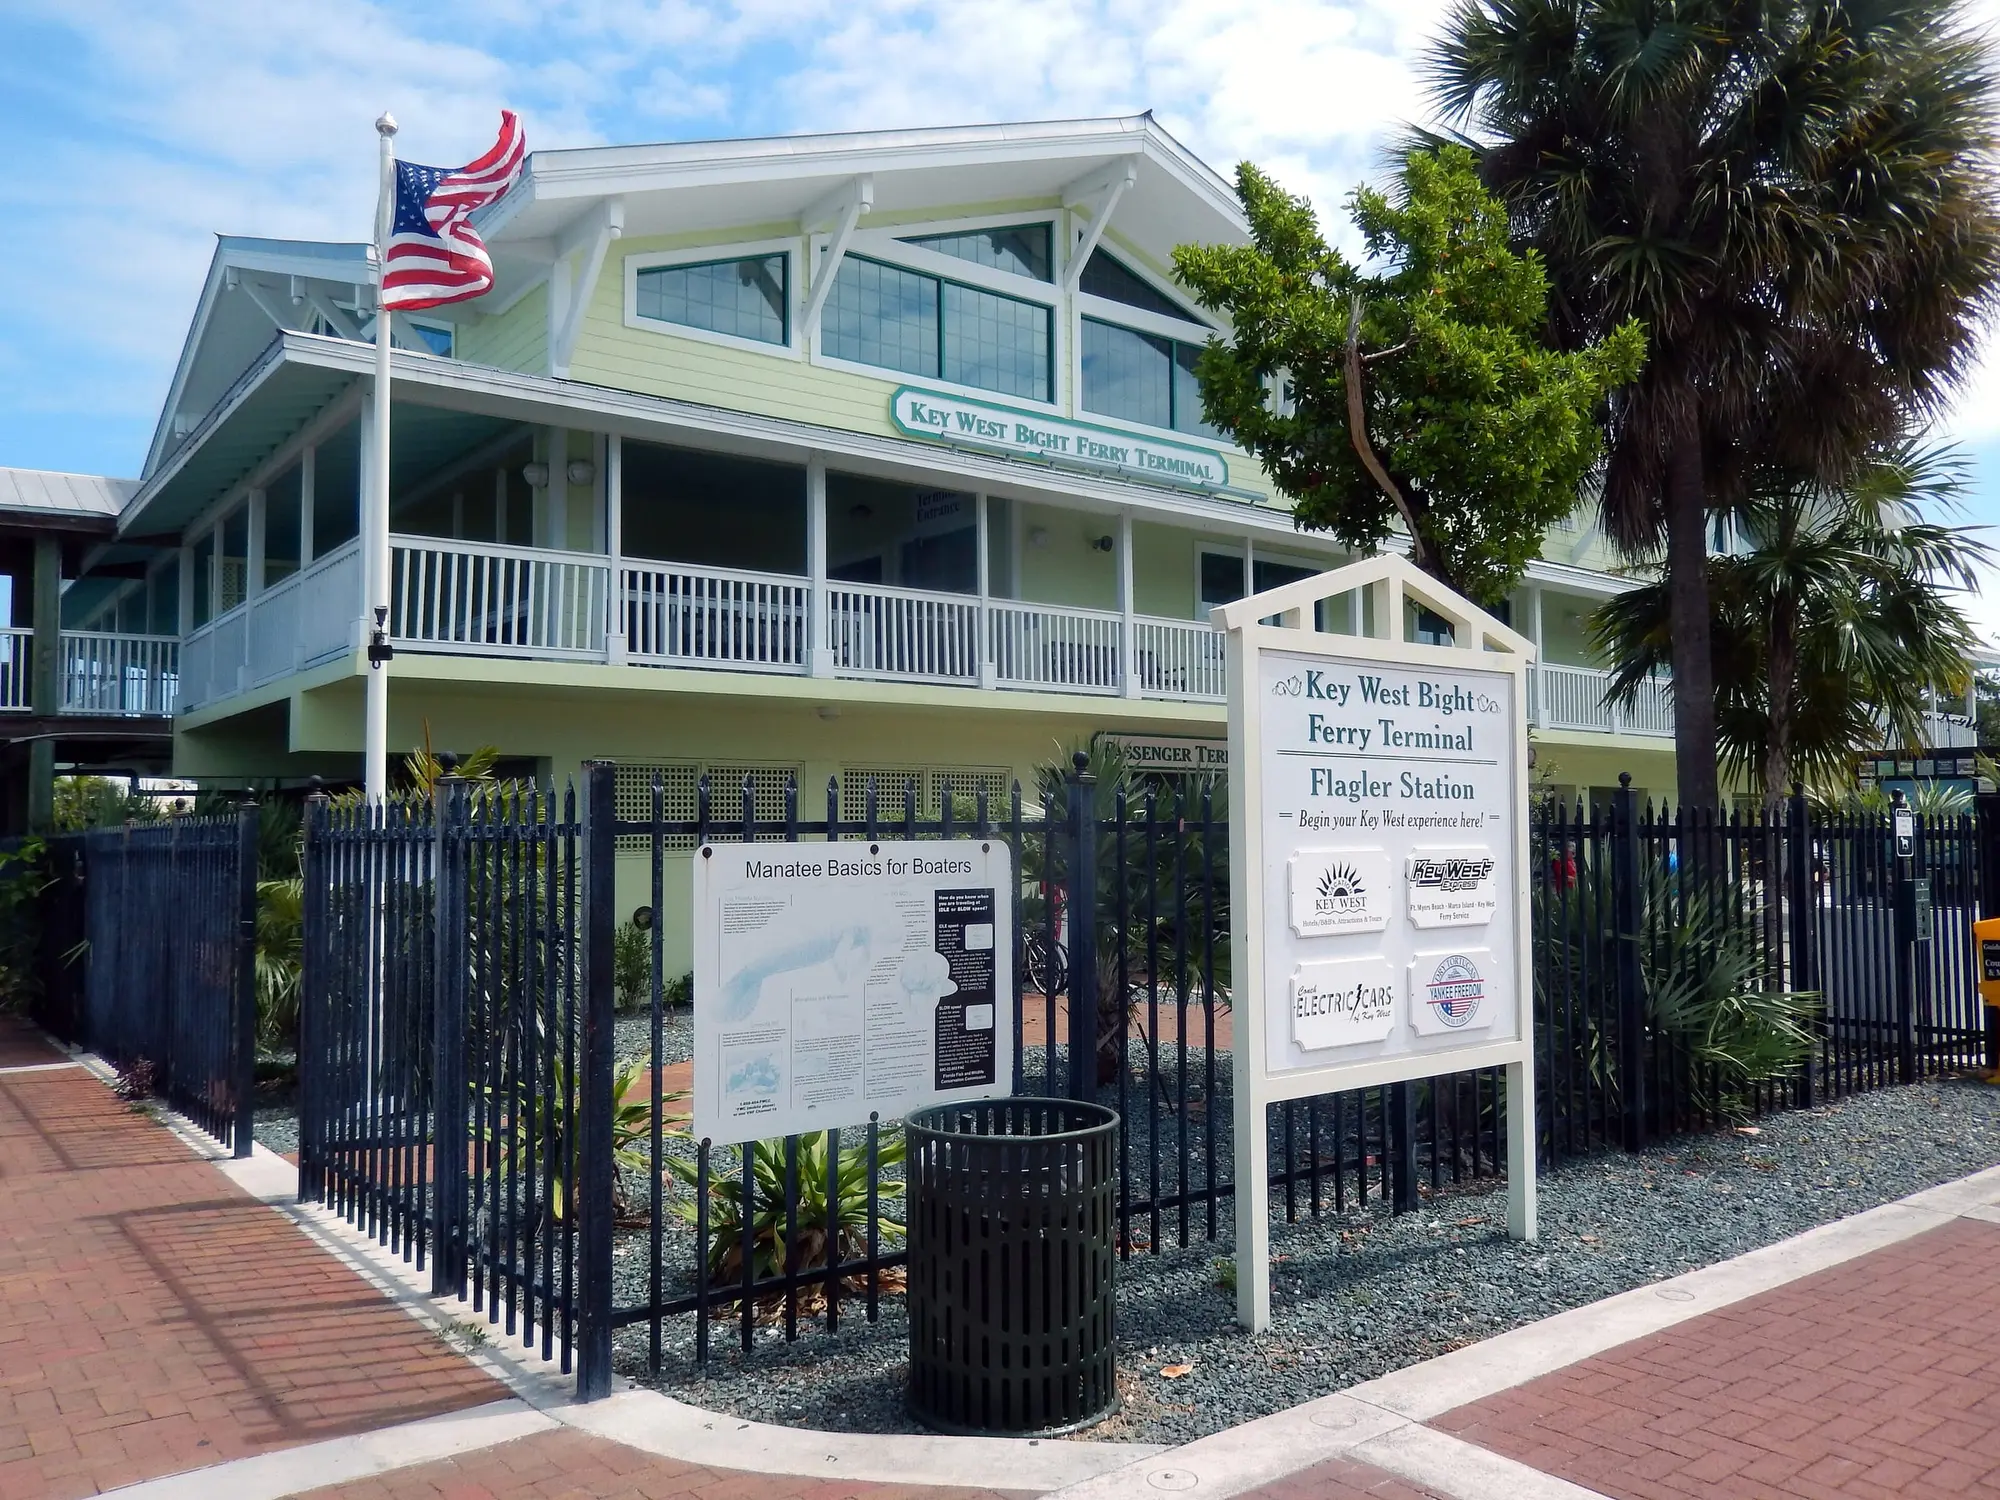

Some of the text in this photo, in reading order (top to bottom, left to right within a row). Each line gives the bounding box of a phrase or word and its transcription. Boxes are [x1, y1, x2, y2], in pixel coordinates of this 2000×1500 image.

[910, 401, 1214, 481] KEY WEST BIGHT FERRY TERMINAL
[1306, 670, 1475, 715] Key West Bight
[1308, 713, 1473, 751] Ferry Terminal
[1105, 741, 1192, 762] PSSENGER
[1310, 768, 1475, 803] Flagler Station
[1299, 810, 1484, 831] Begin your Key West experience here!
[746, 858, 972, 878] Manatee Basics for Boaters
[1328, 880, 1353, 896] VACATION
[1442, 881, 1477, 892] Express
[1315, 897, 1367, 910] KEY WEST
[1439, 912, 1469, 921] Ferry Service
[1296, 986, 1392, 1018] ELECTRIC CARS
[1430, 983, 1481, 1000] YANKEE FREEDOM
